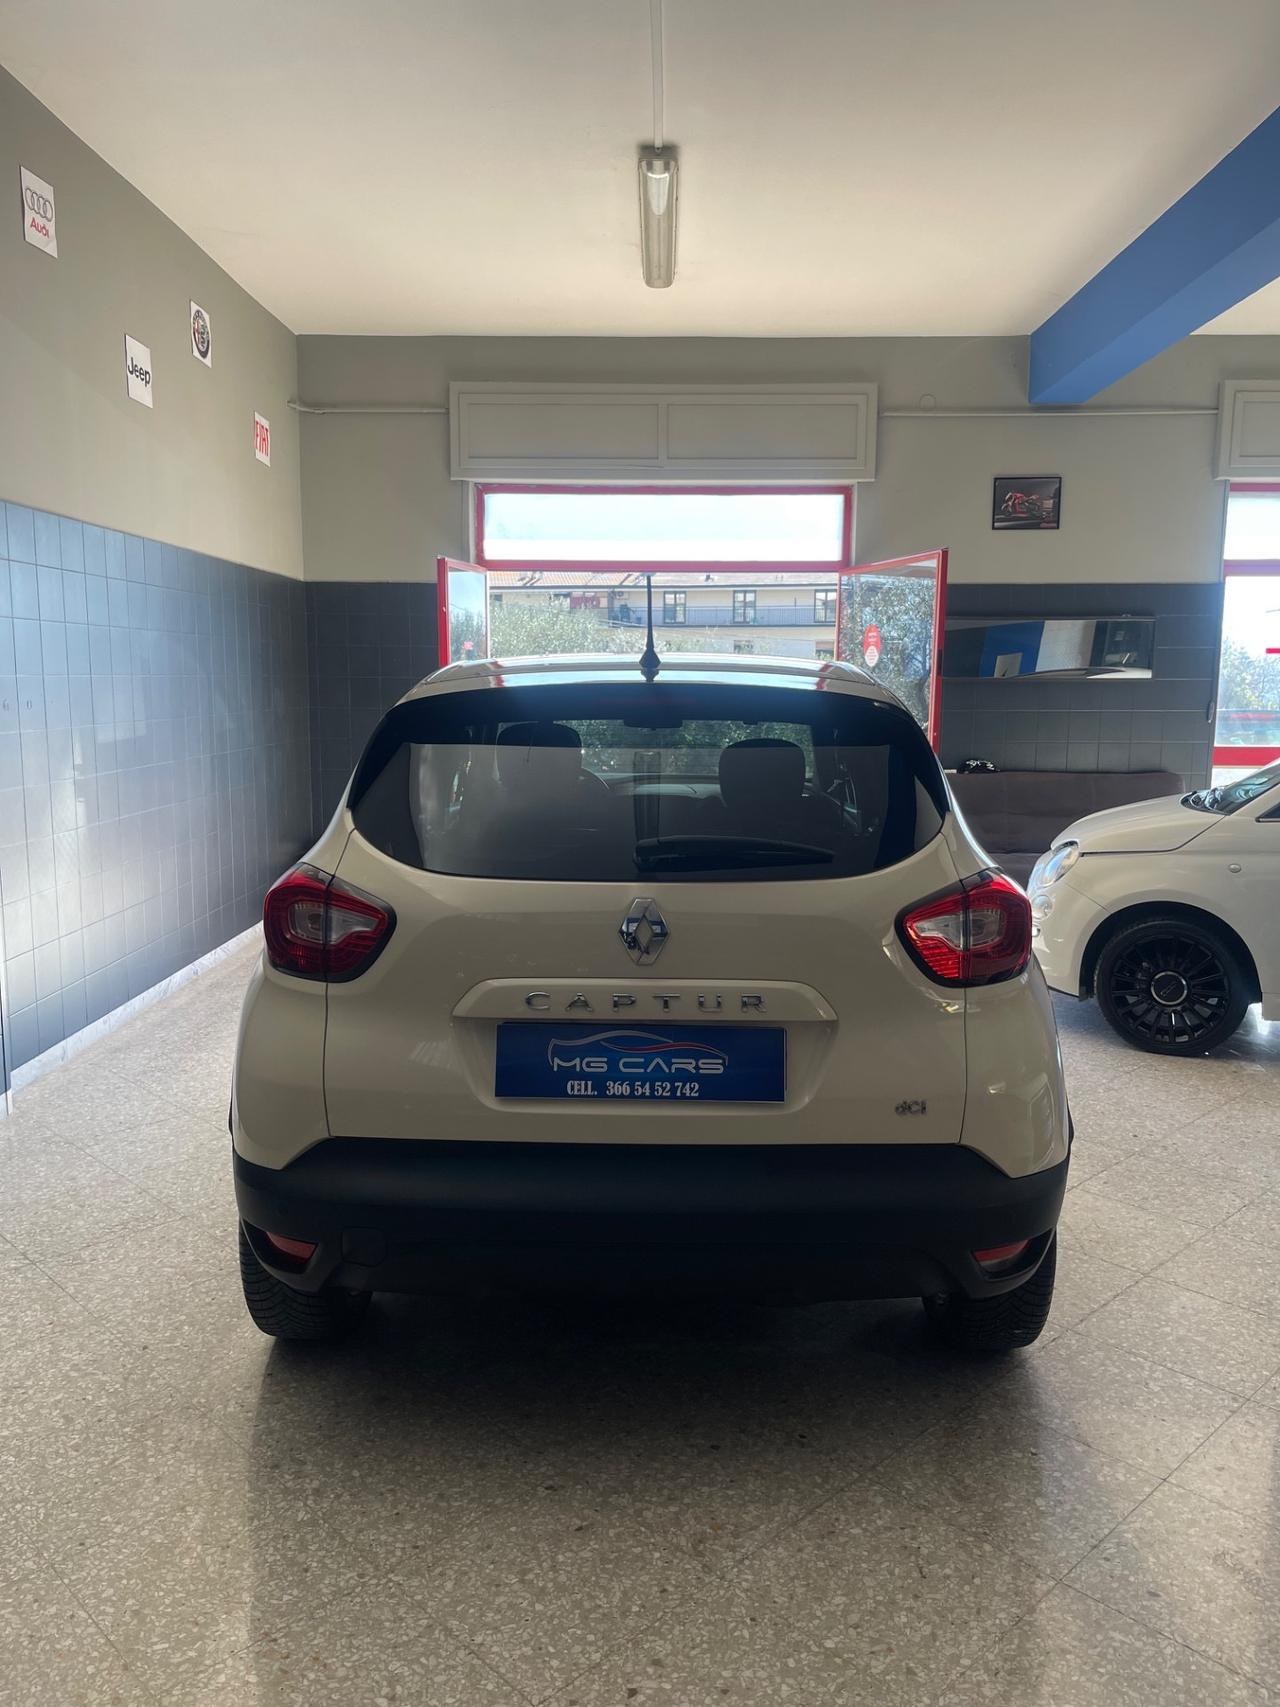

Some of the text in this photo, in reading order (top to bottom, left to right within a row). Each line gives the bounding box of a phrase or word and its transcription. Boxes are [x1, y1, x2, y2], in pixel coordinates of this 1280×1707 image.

[30, 216, 49, 239] Audi
[128, 356, 151, 387] Jeep
[255, 420, 269, 457] FIAT
[525, 991, 767, 1013] CAPTUR
[553, 1056, 724, 1075] MG CARS
[566, 1080, 700, 1097] CELL. 366 54 52 742
